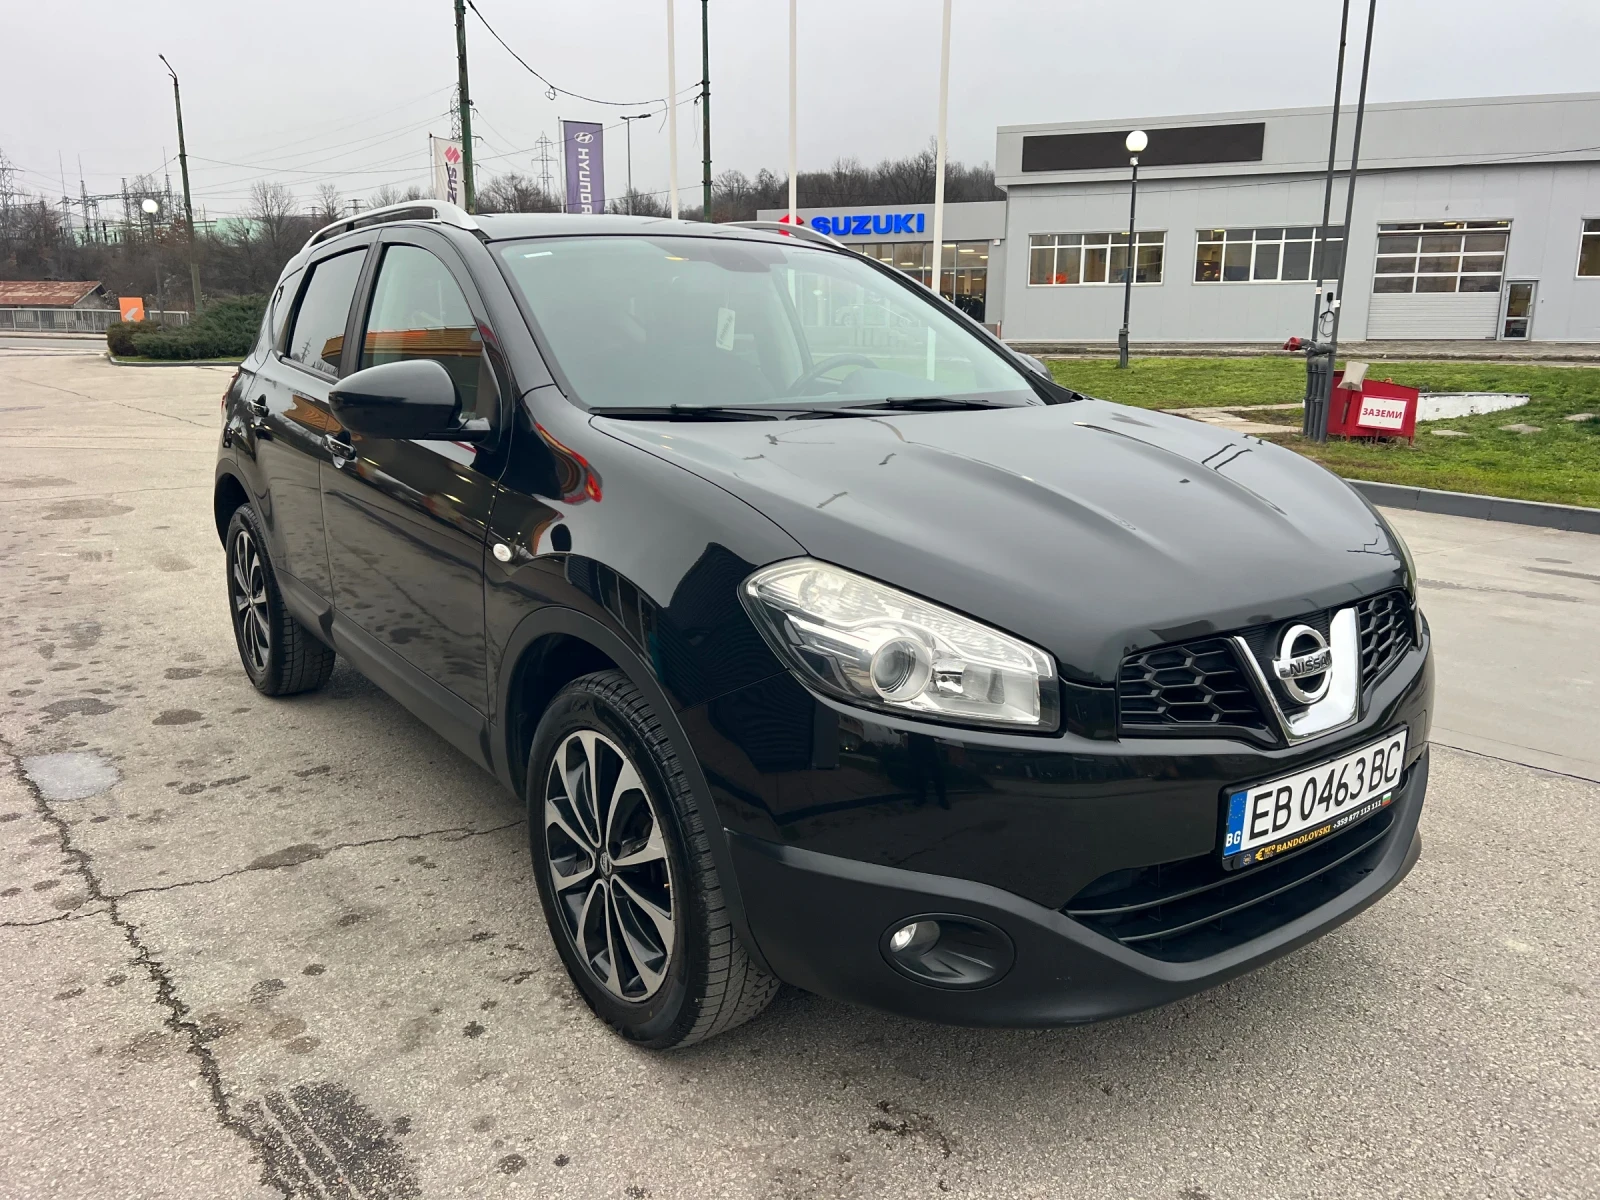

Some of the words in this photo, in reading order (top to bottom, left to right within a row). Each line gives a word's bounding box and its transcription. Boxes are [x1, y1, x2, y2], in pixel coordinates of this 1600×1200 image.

[811, 213, 925, 236] SUZUKI
[1362, 407, 1403, 419] ЗАЗЕМИ
[1249, 785, 1293, 841] EB
[1300, 757, 1366, 821] 0463
[1368, 740, 1401, 793] BC
[1276, 825, 1332, 853] BANDOLOVSKI
[1333, 816, 1349, 829] +359
[1360, 805, 1371, 815] 113
[1371, 799, 1382, 810] 111
[1225, 831, 1241, 847] BG
